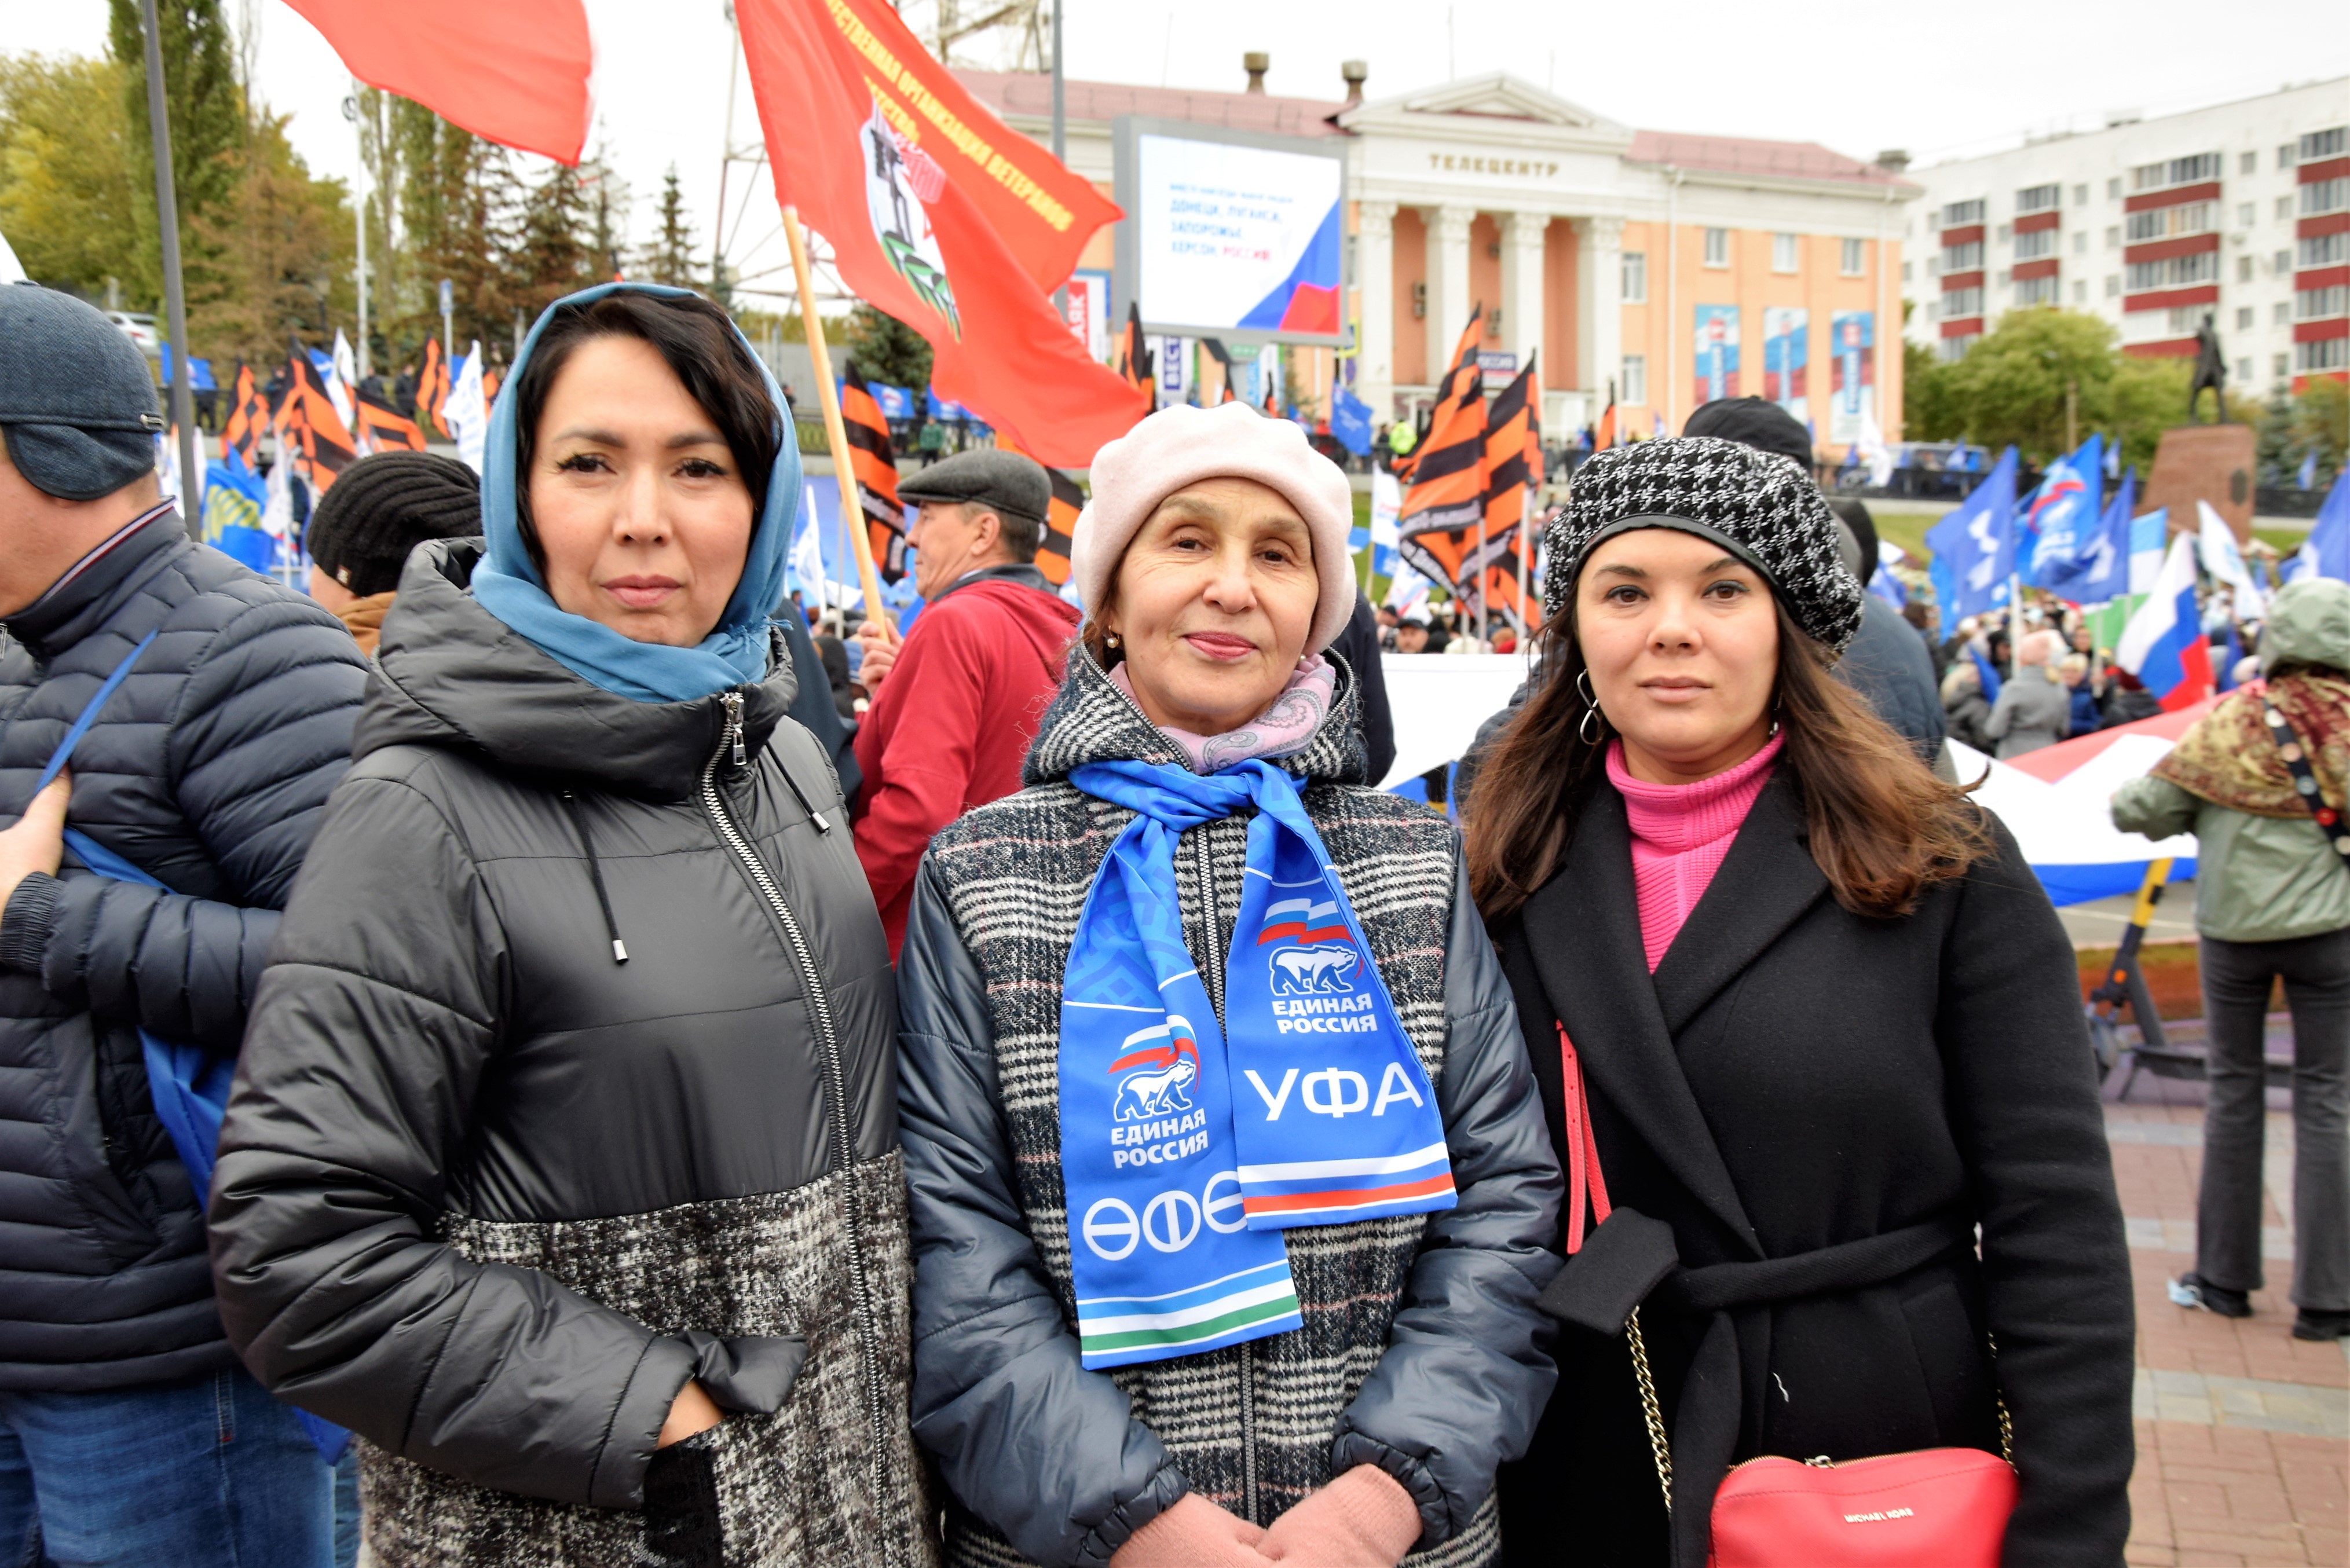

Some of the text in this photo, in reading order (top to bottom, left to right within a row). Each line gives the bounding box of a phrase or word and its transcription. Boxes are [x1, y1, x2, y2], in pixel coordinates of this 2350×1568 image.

[898, 69, 994, 166] ОРГАНИЗАЦИЯ
[1429, 153, 1559, 177] ТЕЛЕЦЕНТР
[1272, 993, 1372, 1017] ЕДИНАЯ
[1277, 1014, 1378, 1034] РОССИЯ
[1243, 1061, 1423, 1121] УФА
[1111, 1108, 1206, 1146] ЕДИНАЯ
[1112, 1130, 1208, 1168] РОССИЯ
[1844, 1508, 1914, 1523] MICHAEL KORS
